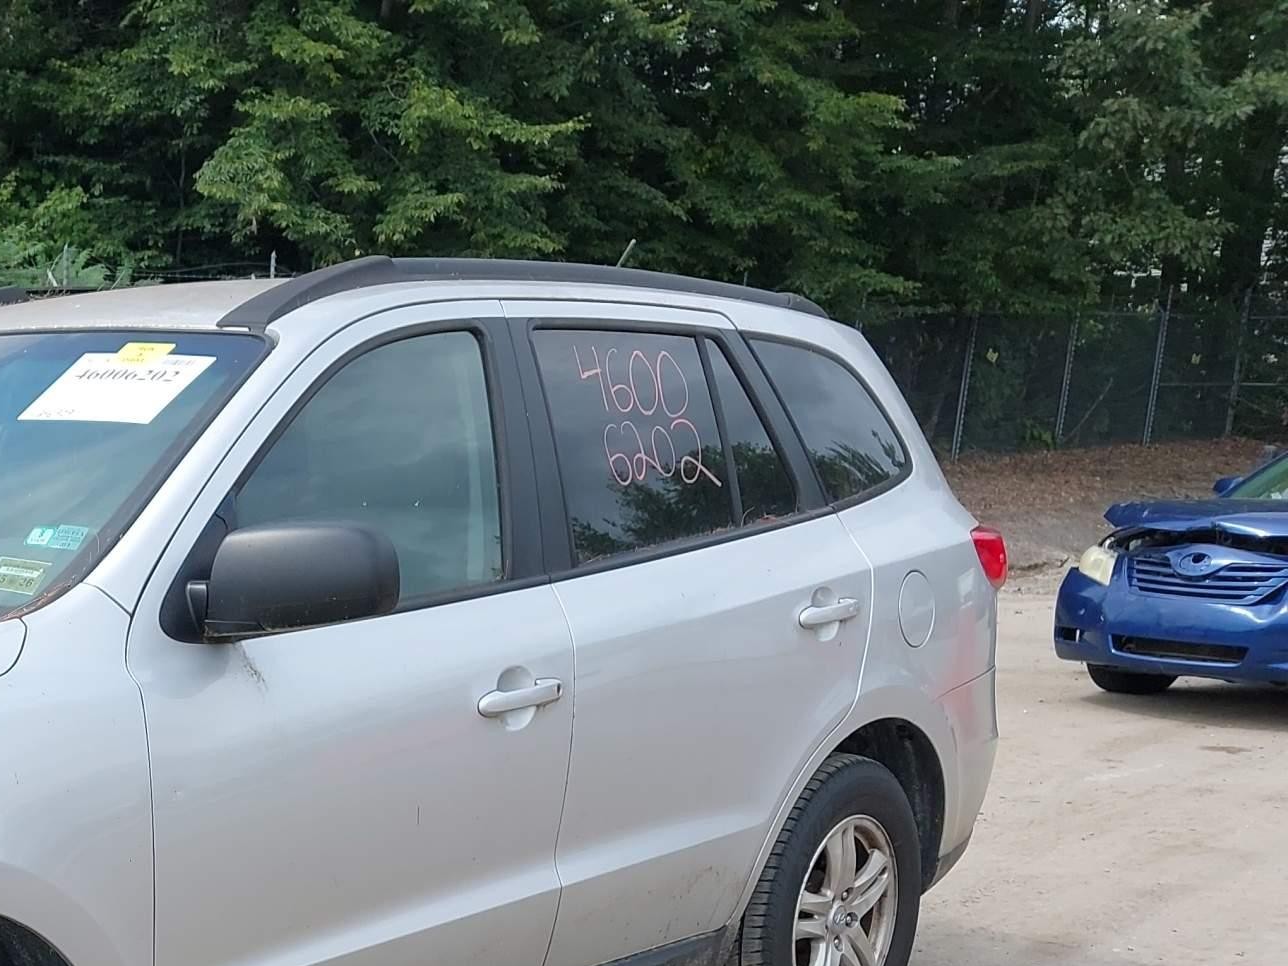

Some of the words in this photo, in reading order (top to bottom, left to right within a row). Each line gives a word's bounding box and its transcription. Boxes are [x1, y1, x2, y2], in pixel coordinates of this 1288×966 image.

[75, 368, 180, 382] 46006202
[574, 344, 689, 418] 4600
[603, 418, 723, 487] 6202
